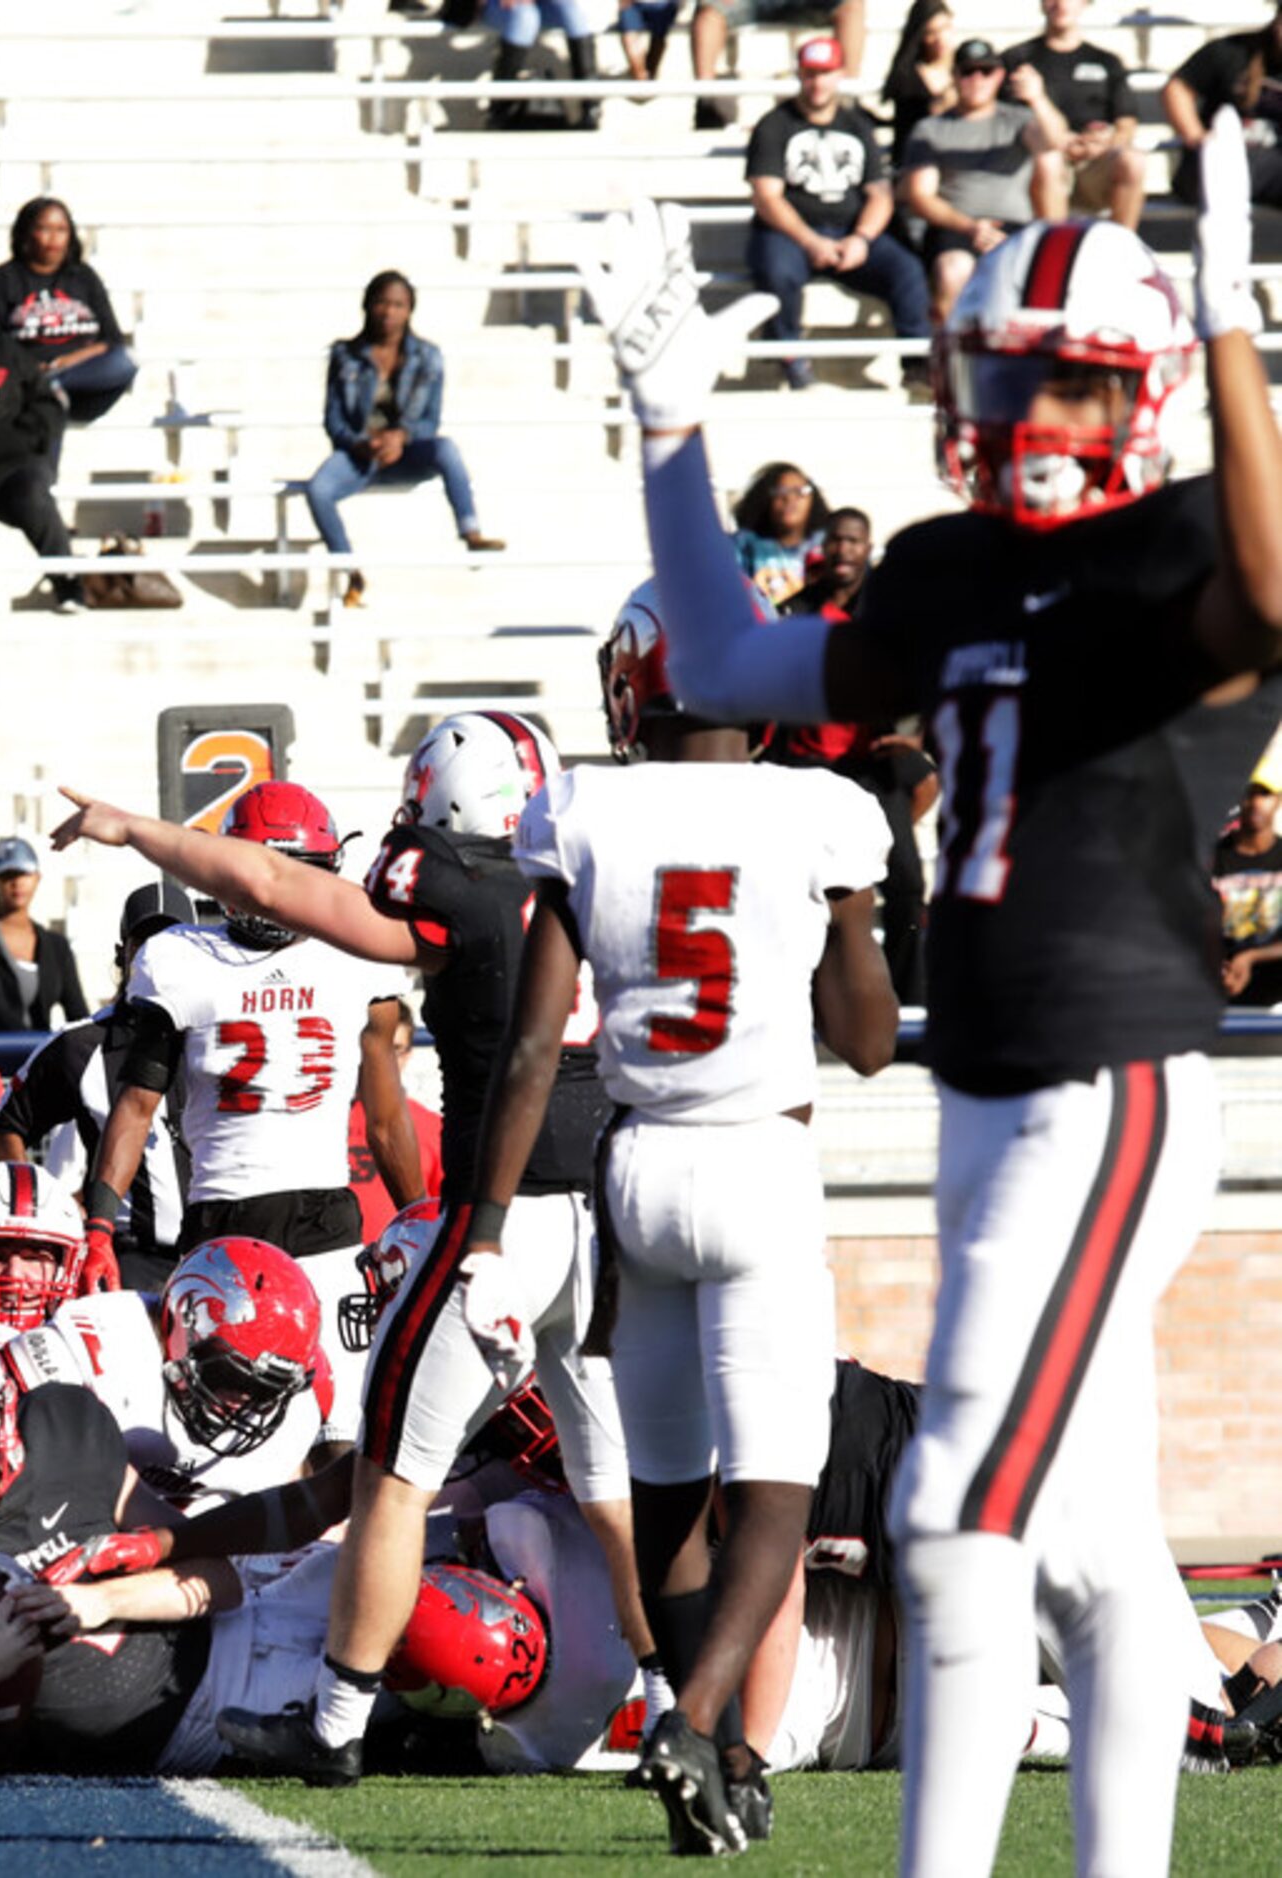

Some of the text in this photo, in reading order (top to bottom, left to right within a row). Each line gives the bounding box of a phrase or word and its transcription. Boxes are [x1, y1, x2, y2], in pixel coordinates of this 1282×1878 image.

[181, 731, 276, 834] 2
[242, 986, 315, 1014] HORN
[650, 866, 739, 1055] 5
[215, 1016, 336, 1115] 23
[15, 1532, 79, 1574] PPELL
